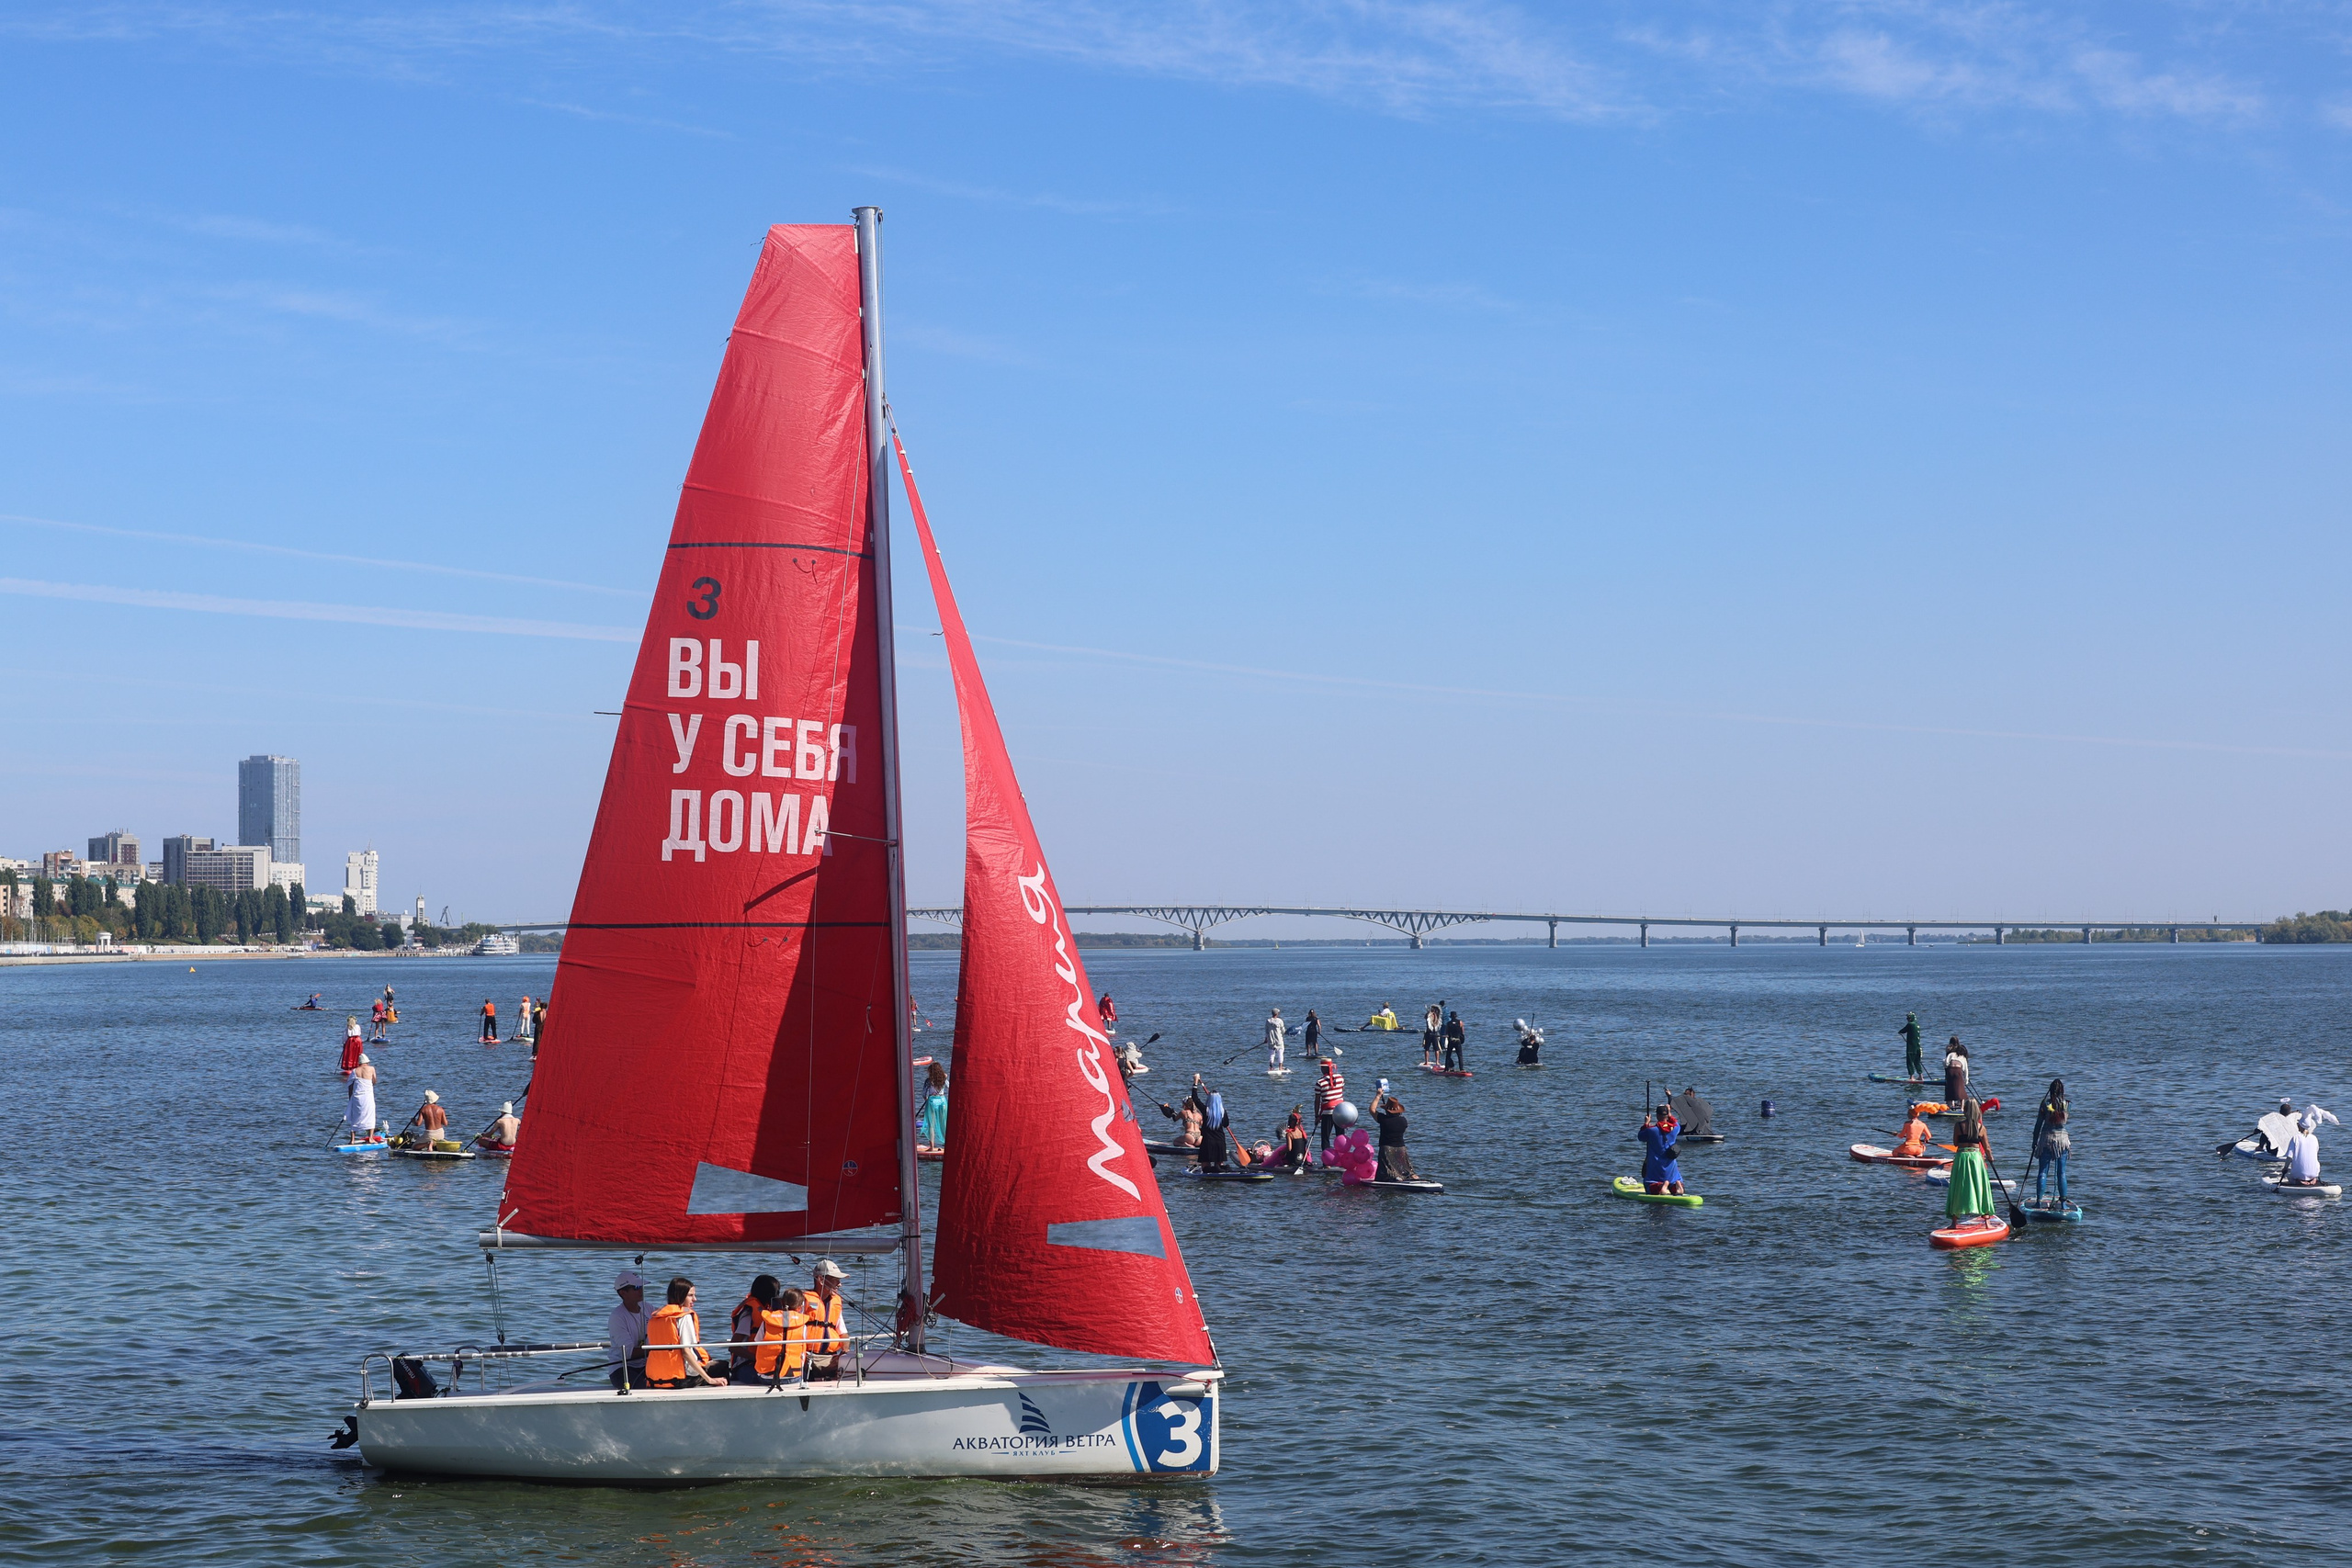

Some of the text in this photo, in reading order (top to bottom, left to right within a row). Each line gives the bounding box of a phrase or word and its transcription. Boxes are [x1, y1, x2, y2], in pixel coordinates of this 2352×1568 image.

[686, 576, 722, 621] 3
[666, 637, 760, 701] ВЫ
[666, 713, 857, 784] У СЕБЯ
[661, 788, 833, 863] ДОМА
[952, 1434, 1116, 1450] АКВАТОРИЯ ВЕТРА
[1156, 1400, 1203, 1468] 3
